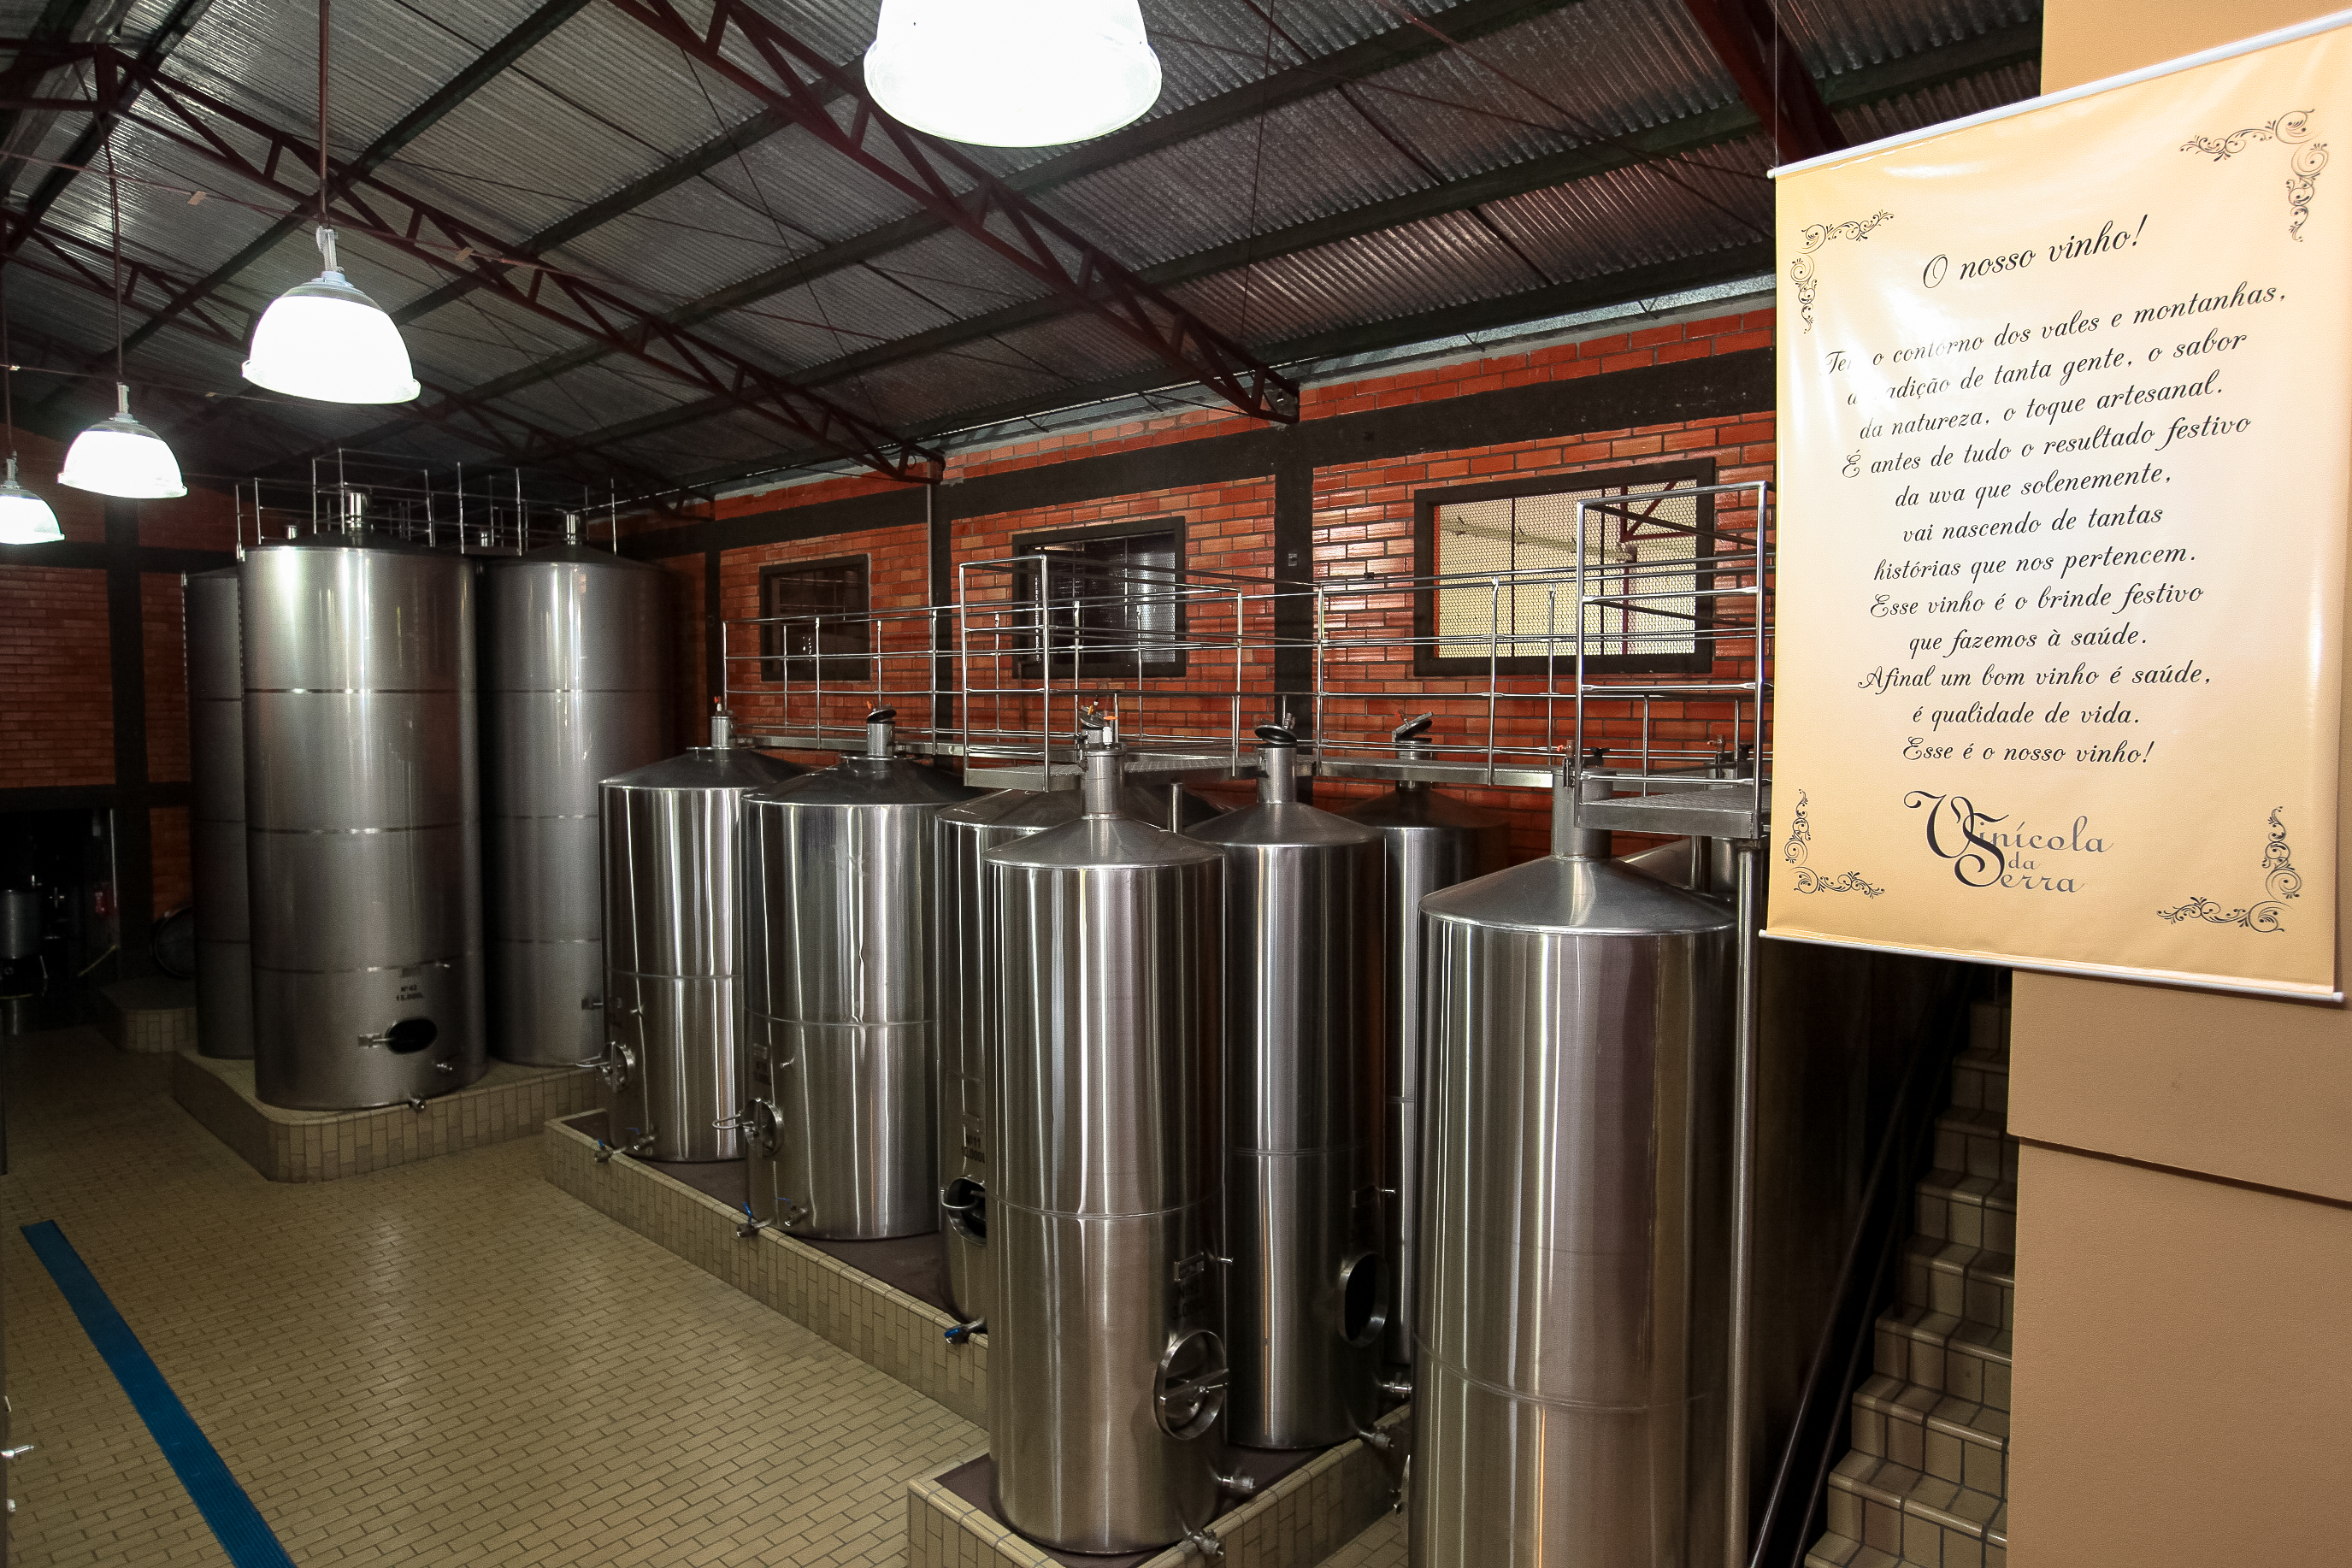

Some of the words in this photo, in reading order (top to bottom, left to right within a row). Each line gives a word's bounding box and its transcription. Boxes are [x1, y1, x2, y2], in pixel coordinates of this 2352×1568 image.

[1923, 254, 1948, 288] O
[1960, 251, 2036, 280] nosso
[2048, 214, 2148, 262] vinho!
[1825, 350, 1854, 374] Te
[1873, 353, 1884, 365] o
[1893, 337, 1984, 363] contorno
[1995, 323, 2031, 346] dos
[2042, 310, 2099, 339] vales
[2111, 314, 2122, 327] e
[2133, 281, 2285, 324] montanhas,
[1960, 367, 1984, 389] de
[1995, 360, 2052, 384] tanta
[2060, 348, 2131, 386] gente,
[2149, 348, 2163, 362] o
[2173, 327, 2247, 357] sabor
[1860, 418, 1883, 439] da
[1892, 412, 1989, 435] natureza,
[2004, 408, 2016, 421] o
[2026, 398, 2085, 425] toque
[2097, 369, 2222, 409] artesanal.
[1842, 450, 1861, 478] É
[1871, 452, 1921, 473] antes
[1931, 445, 1954, 467] de
[1964, 439, 2012, 463] tudo
[2021, 444, 2034, 457] o
[2043, 421, 2155, 454] resultado
[2155, 416, 2251, 451] festivo
[1895, 486, 1919, 506] da
[1930, 489, 1965, 504] uva
[1976, 484, 2011, 509] que
[2021, 463, 2170, 495] solenemente,
[1903, 524, 1933, 542] vai
[1942, 511, 2042, 539] nascendo
[2052, 508, 2077, 531] de
[2088, 504, 2163, 528] tantas
[1874, 559, 1960, 581] histórias
[1971, 560, 2006, 584] que
[2016, 557, 2054, 571] nos
[2060, 546, 2195, 579] pertencem.
[1871, 594, 1918, 617] Esse
[1928, 590, 1985, 613] vinho
[1995, 593, 2006, 610] é
[2015, 597, 2028, 610] o
[2038, 584, 2111, 608] brinde
[2112, 583, 2204, 614] festivo
[1910, 638, 1942, 659] que
[1942, 629, 2037, 657] fazemos
[2048, 629, 2060, 646] à
[2071, 622, 2146, 645] saúde.
[1858, 665, 1935, 695] Afinal
[1942, 674, 1972, 686] um
[1982, 663, 2025, 686] bom
[2036, 662, 2099, 685] vinho
[2110, 666, 2123, 684] é
[2131, 660, 2210, 684] saúde,
[1913, 706, 1924, 722] é
[1931, 701, 2034, 732] qualidade
[2045, 701, 2070, 723] de
[2081, 701, 2138, 723] vida.
[1903, 736, 1953, 760] Esse
[1963, 743, 1974, 759] é
[1983, 748, 1995, 760] o
[2003, 748, 2066, 761] nosso
[2075, 740, 2155, 763] vinho!
[1904, 791, 2113, 858] Vinícola
[1954, 813, 2085, 893] Serra
[2008, 852, 2042, 870] da
